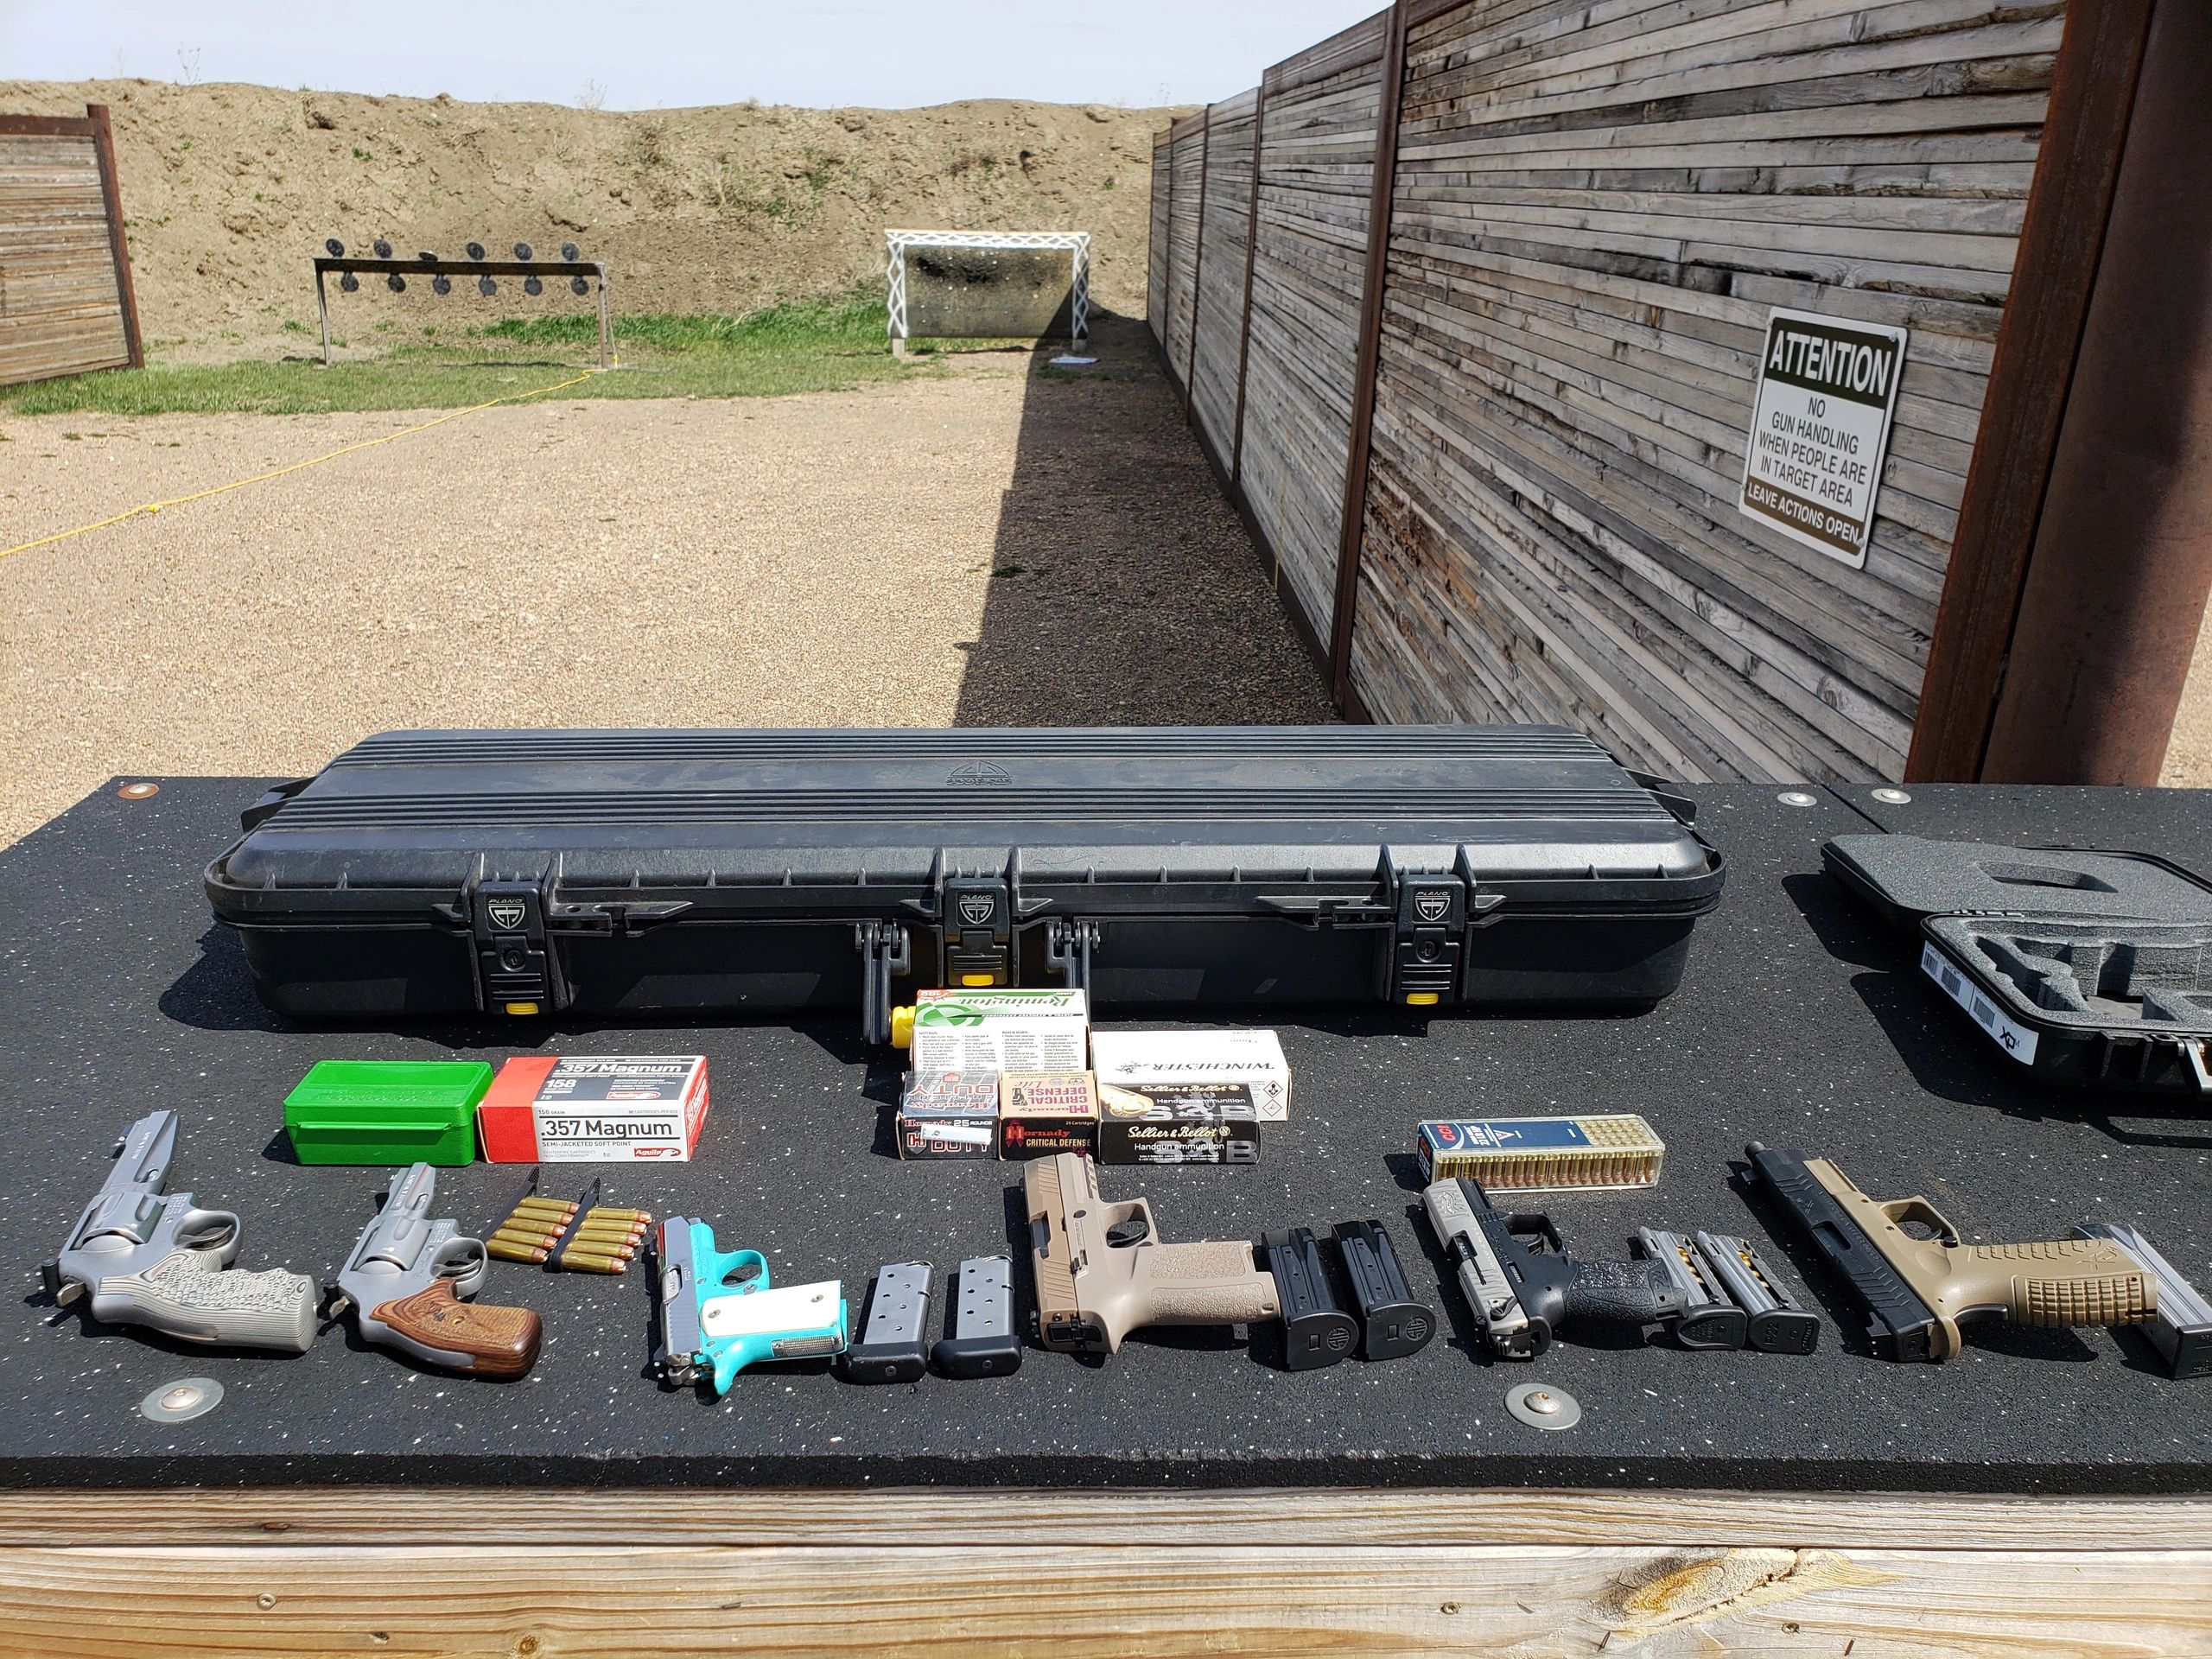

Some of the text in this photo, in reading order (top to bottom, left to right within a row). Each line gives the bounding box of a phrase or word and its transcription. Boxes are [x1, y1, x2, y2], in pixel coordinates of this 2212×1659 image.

[1769, 330, 1892, 397] ATTENTION
[1808, 397, 1826, 418] NO
[1772, 411, 1859, 455] GUN HANDLING
[1759, 430, 1867, 486] WHEN PEOPLE ARE
[1760, 456, 1853, 508] IN TARGET AREA
[1748, 481, 1859, 545] LEAVE ACTIONS OPEN
[961, 996, 1070, 1007] Remington
[598, 1065, 682, 1074] Magnum
[1154, 1062, 1274, 1071] WINCHESTER
[545, 1079, 577, 1088] 158
[906, 1084, 995, 1096] DUTY
[1027, 1087, 1087, 1096] DEFENSE
[1028, 1096, 1088, 1104] CRITICAL
[541, 1119, 673, 1138] .357 Magnum
[1005, 1125, 1071, 1141] Hornady
[1128, 1126, 1217, 1138] Sellier & Bellot
[1437, 1124, 1456, 1141] CCI
[1135, 1143, 1174, 1152] Handgun
[1764, 1322, 1780, 1346] P22
